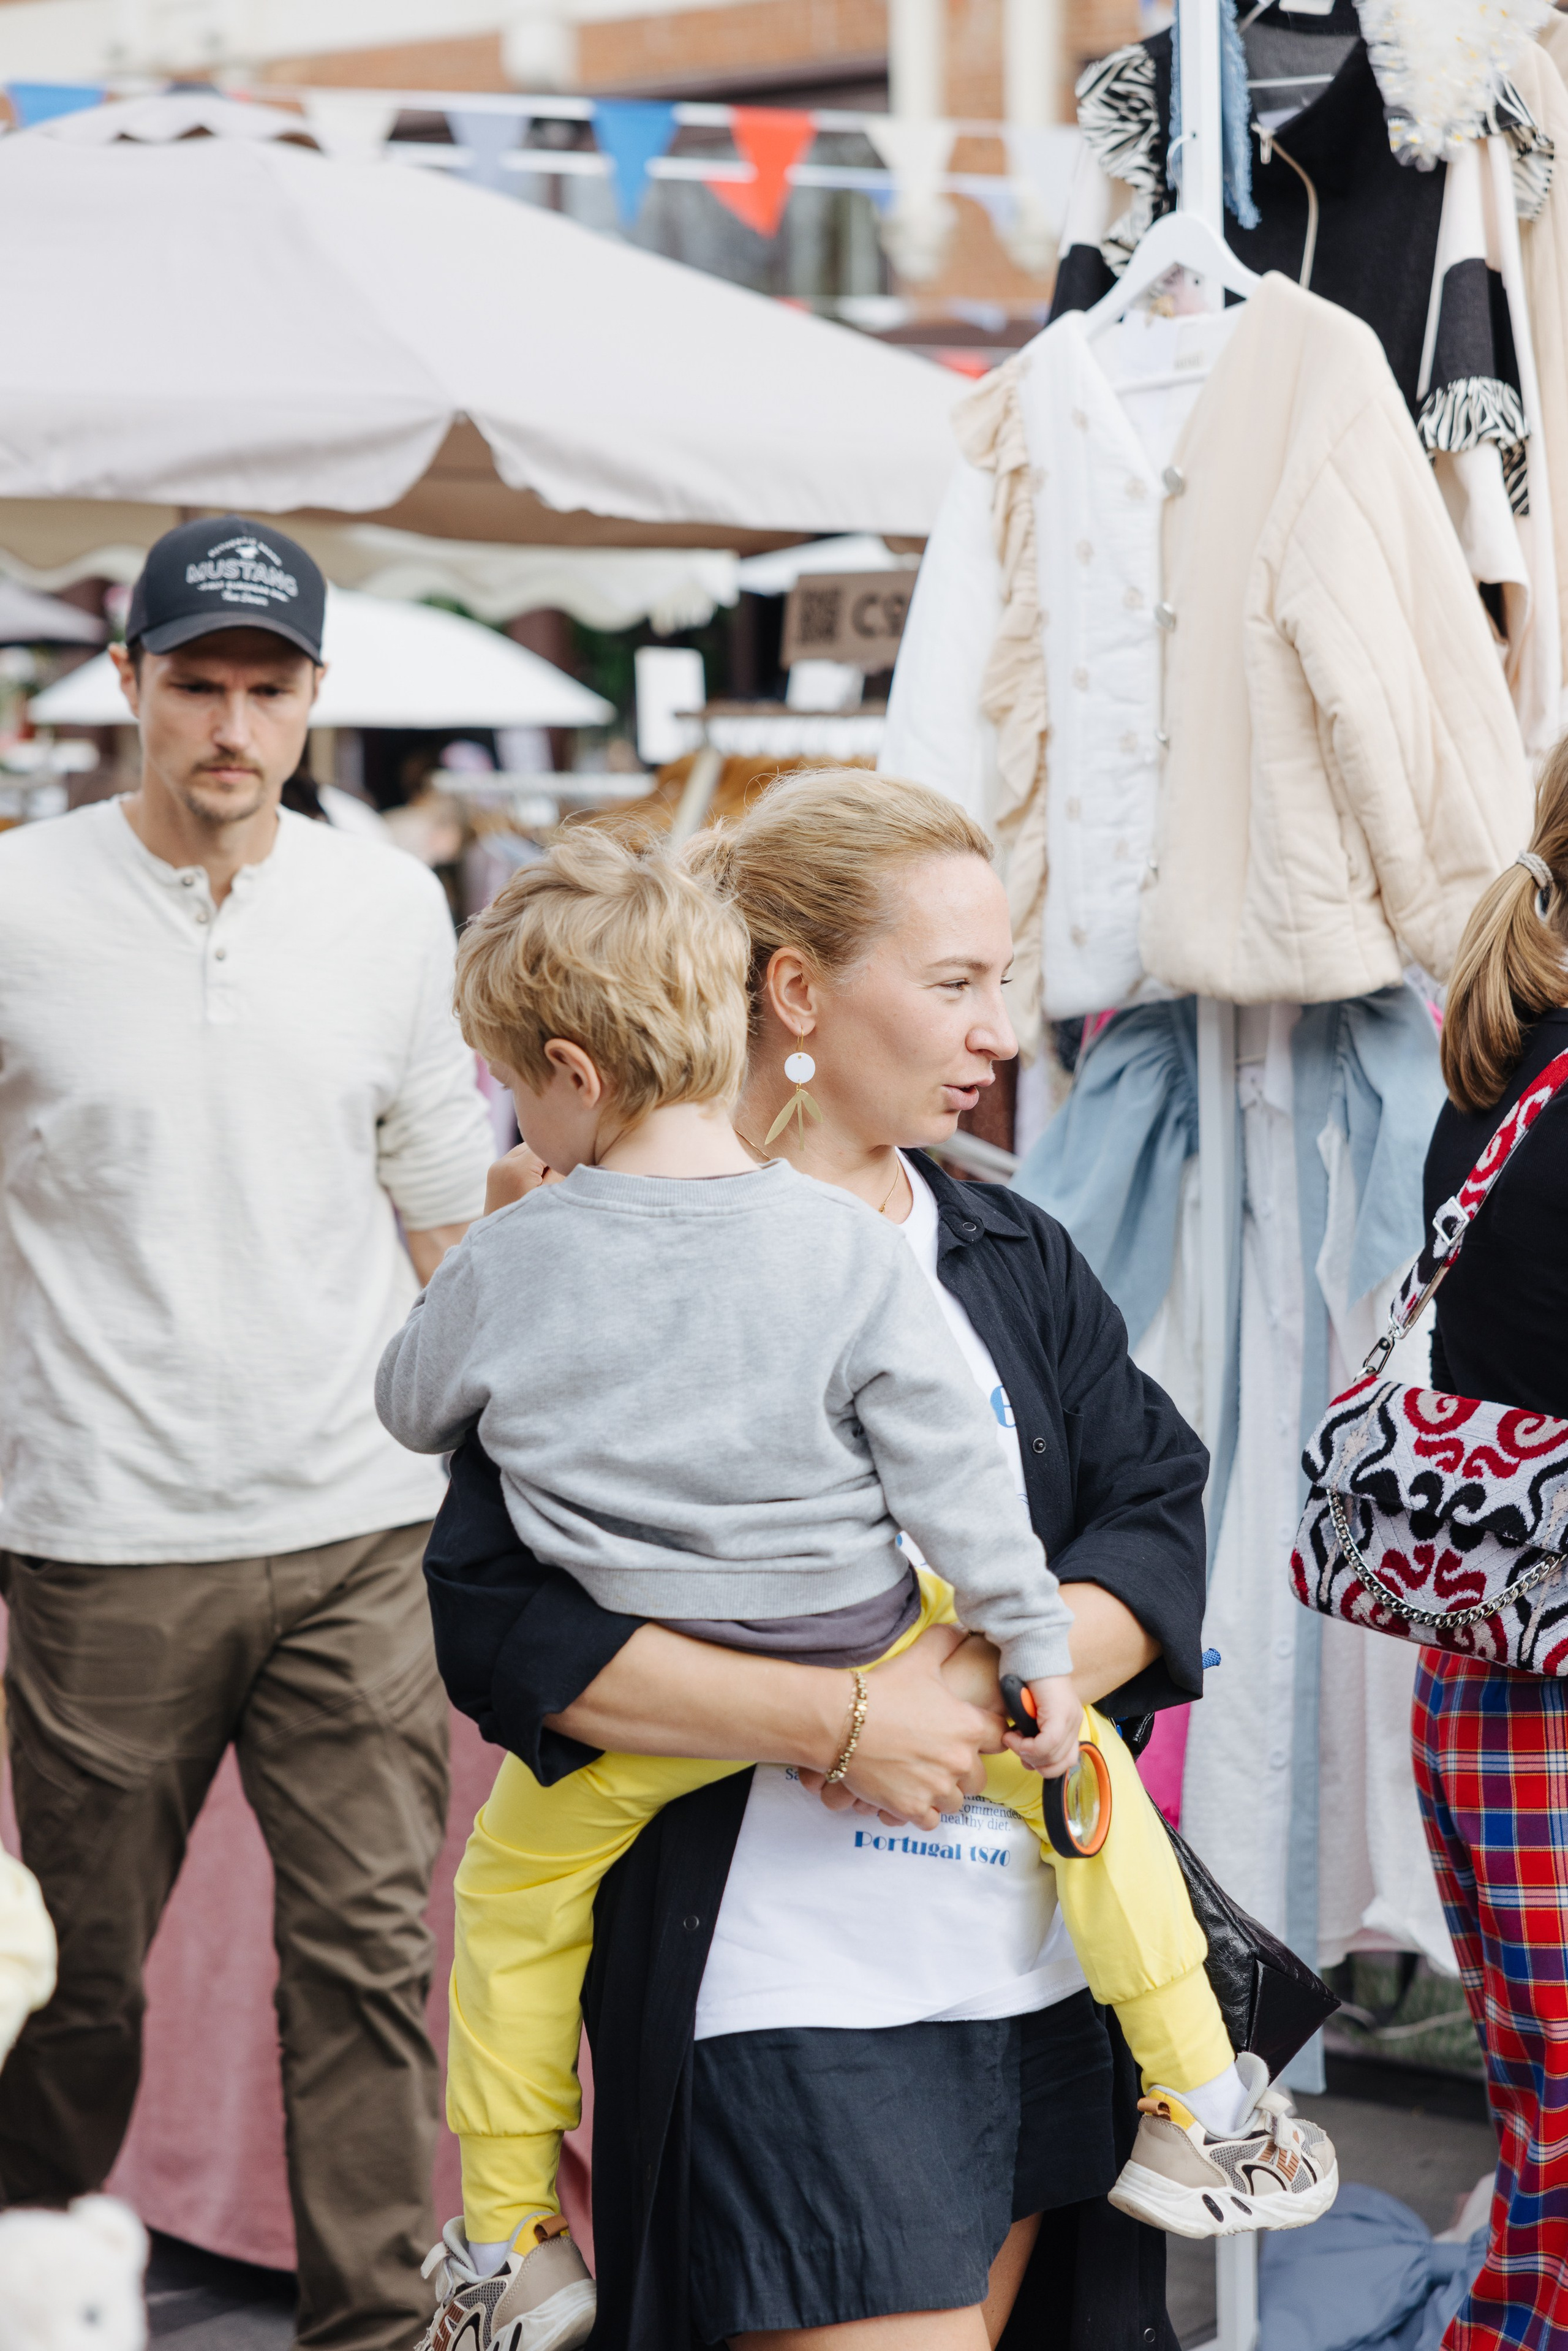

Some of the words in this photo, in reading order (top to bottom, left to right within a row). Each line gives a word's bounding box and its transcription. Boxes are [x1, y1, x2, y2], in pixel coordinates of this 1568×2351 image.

[186, 557, 299, 597] MUSTANG
[959, 1804, 1022, 1820] ommende
[987, 1817, 1011, 1832] diet.
[854, 1830, 962, 1860] Portugal
[968, 1845, 1011, 1867] 1870
